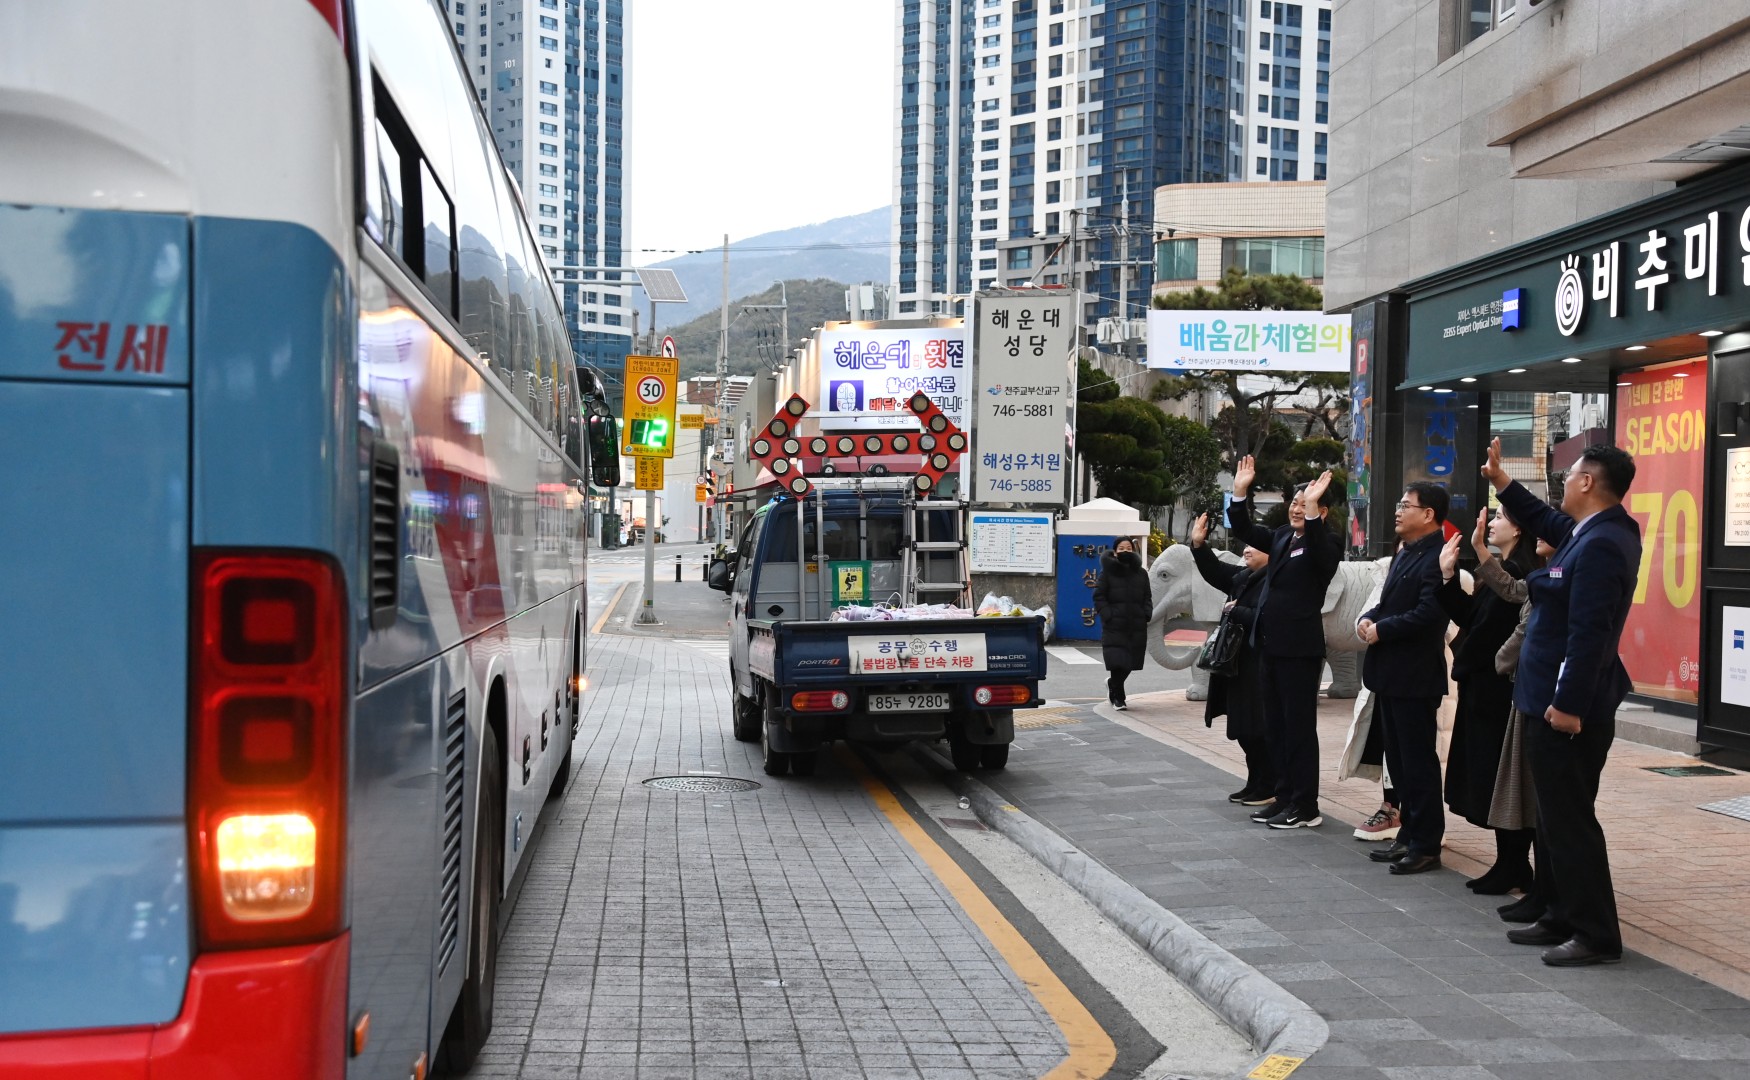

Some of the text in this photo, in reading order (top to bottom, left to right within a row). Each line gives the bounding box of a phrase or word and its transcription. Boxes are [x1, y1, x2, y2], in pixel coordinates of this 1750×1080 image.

[504, 60, 516, 68] 101
[991, 308, 1060, 330] 해운대
[1443, 326, 1456, 338] ZEISS
[1457, 322, 1472, 336] Expert
[1473, 317, 1490, 333] Optical
[55, 321, 169, 374] 전세
[1004, 334, 1047, 357] 성당
[834, 340, 910, 369] 해운대
[643, 383, 660, 397] 30
[1004, 386, 1060, 396] 천주교부산교구
[992, 404, 1053, 417] 746-5881
[642, 419, 669, 447] 12
[983, 452, 1060, 471] 해성유치원
[989, 479, 1052, 492] 746-5885
[1630, 489, 1698, 609] 70
[878, 641, 908, 653] 공무
[928, 639, 958, 652] 수행
[924, 656, 947, 668] 단속
[951, 655, 974, 668] 차량
[875, 695, 943, 709] 85누 9280
